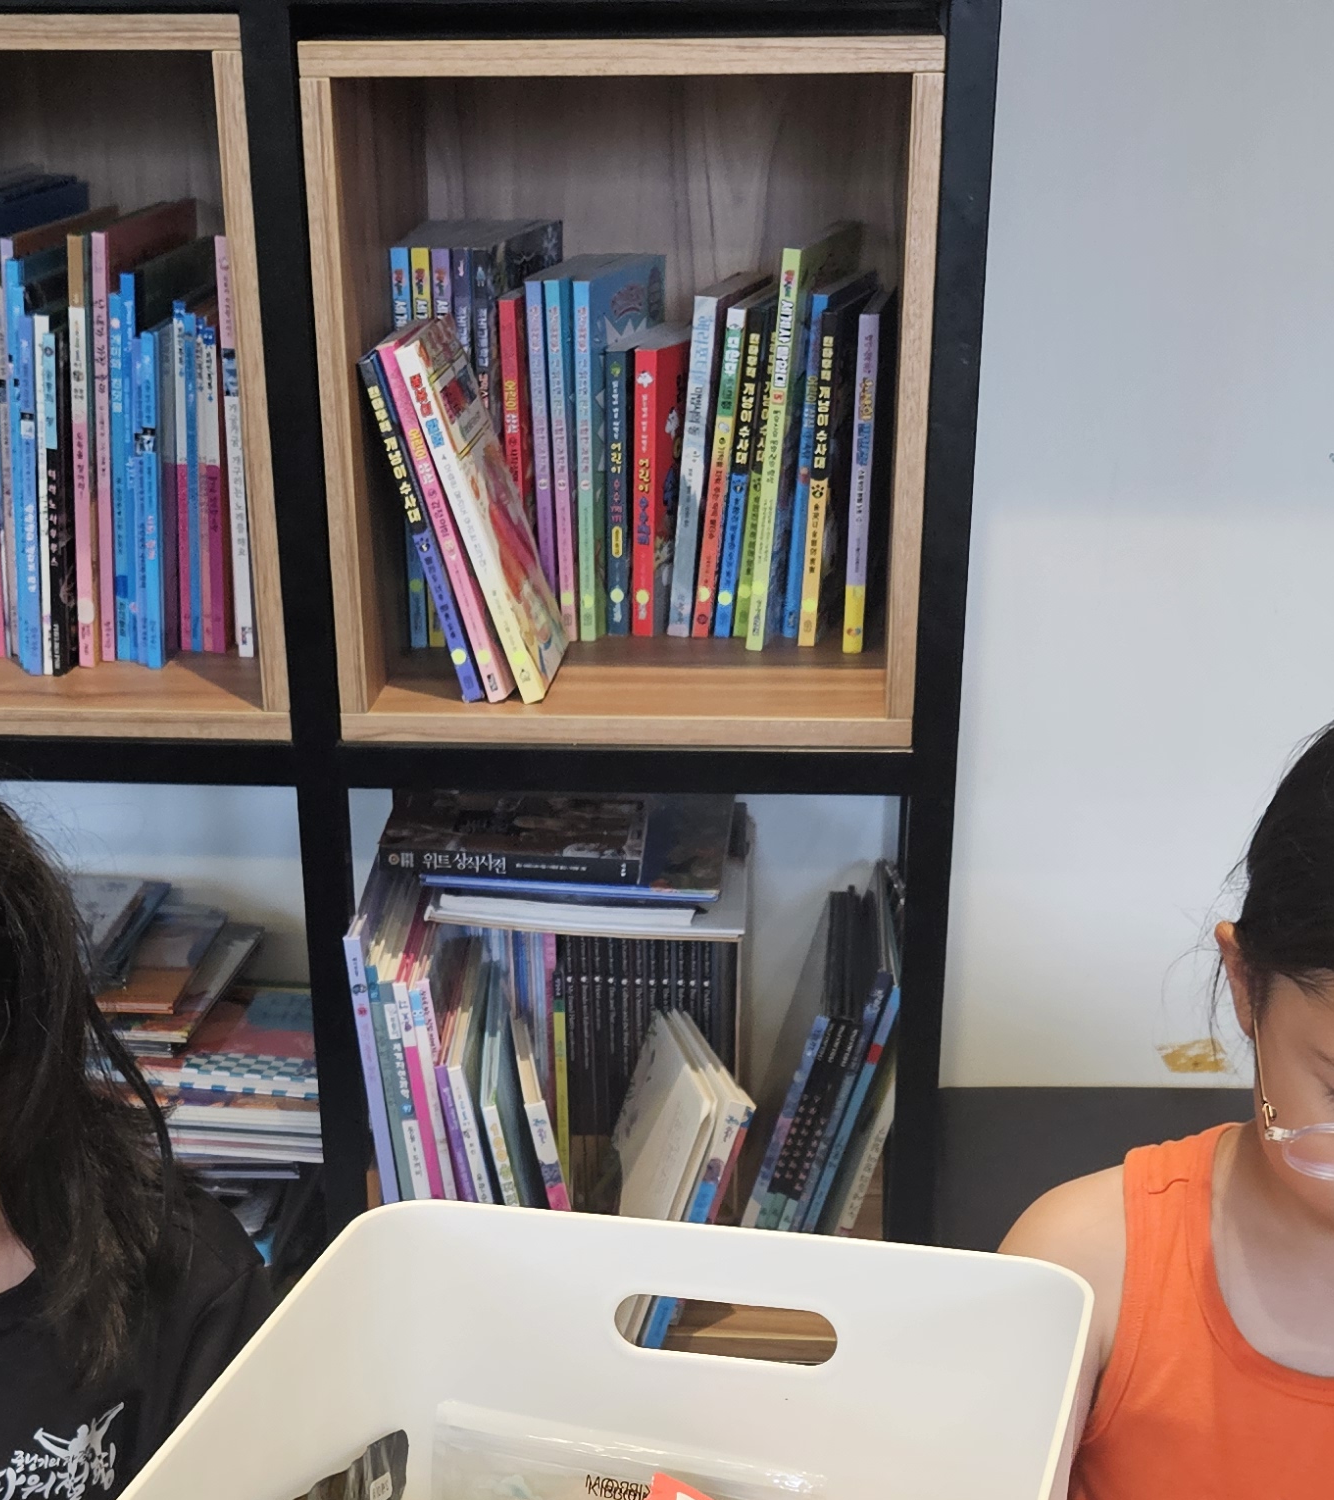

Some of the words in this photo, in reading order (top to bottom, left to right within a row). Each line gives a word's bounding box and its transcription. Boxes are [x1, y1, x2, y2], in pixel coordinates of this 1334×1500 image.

[736, 426, 750, 464] 수사대
[814, 430, 828, 469] 수사대
[398, 481, 421, 524] 수사대
[422, 853, 452, 870] 위트
[452, 852, 507, 875] 상식사전
